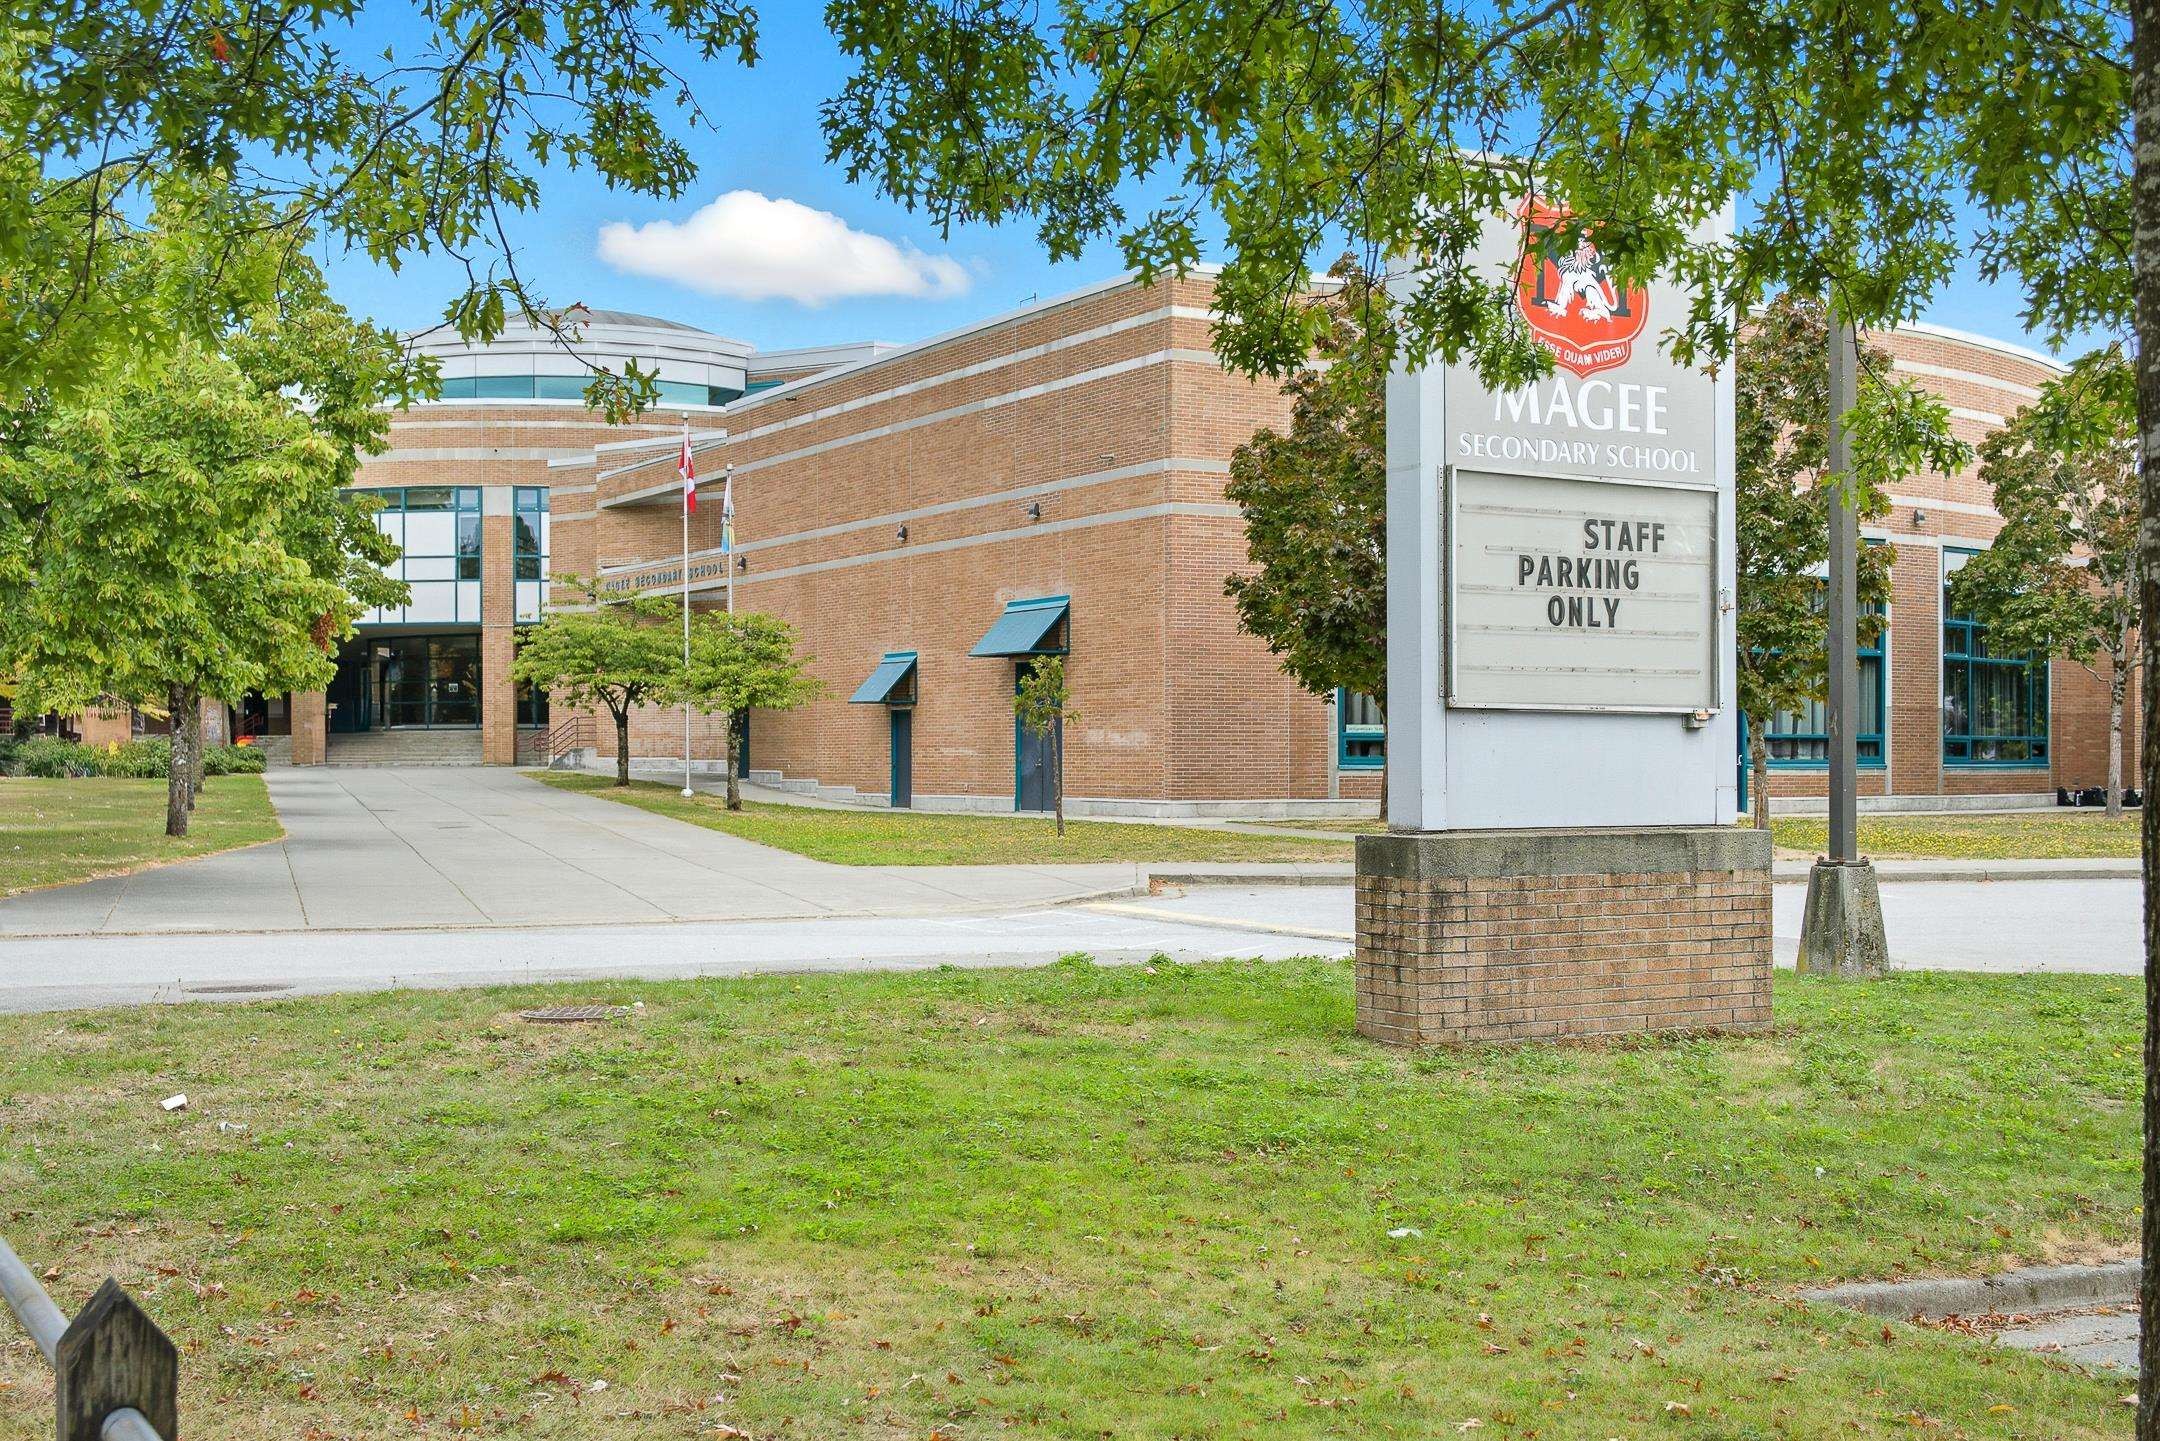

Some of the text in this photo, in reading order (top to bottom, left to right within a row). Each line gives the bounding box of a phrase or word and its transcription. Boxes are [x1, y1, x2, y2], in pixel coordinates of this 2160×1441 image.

[1564, 349, 1593, 365] QUAM
[1593, 344, 1626, 364] VIDERI
[1494, 376, 1668, 435] MAGEE
[1458, 432, 1699, 473] SECONDARY SCHOOL
[1583, 518, 1665, 553] STAFF
[634, 568, 683, 588] SECONDARY
[687, 561, 724, 580] SCHOOL
[1518, 554, 1640, 590] PARKING
[1547, 595, 1621, 628] ONLY
